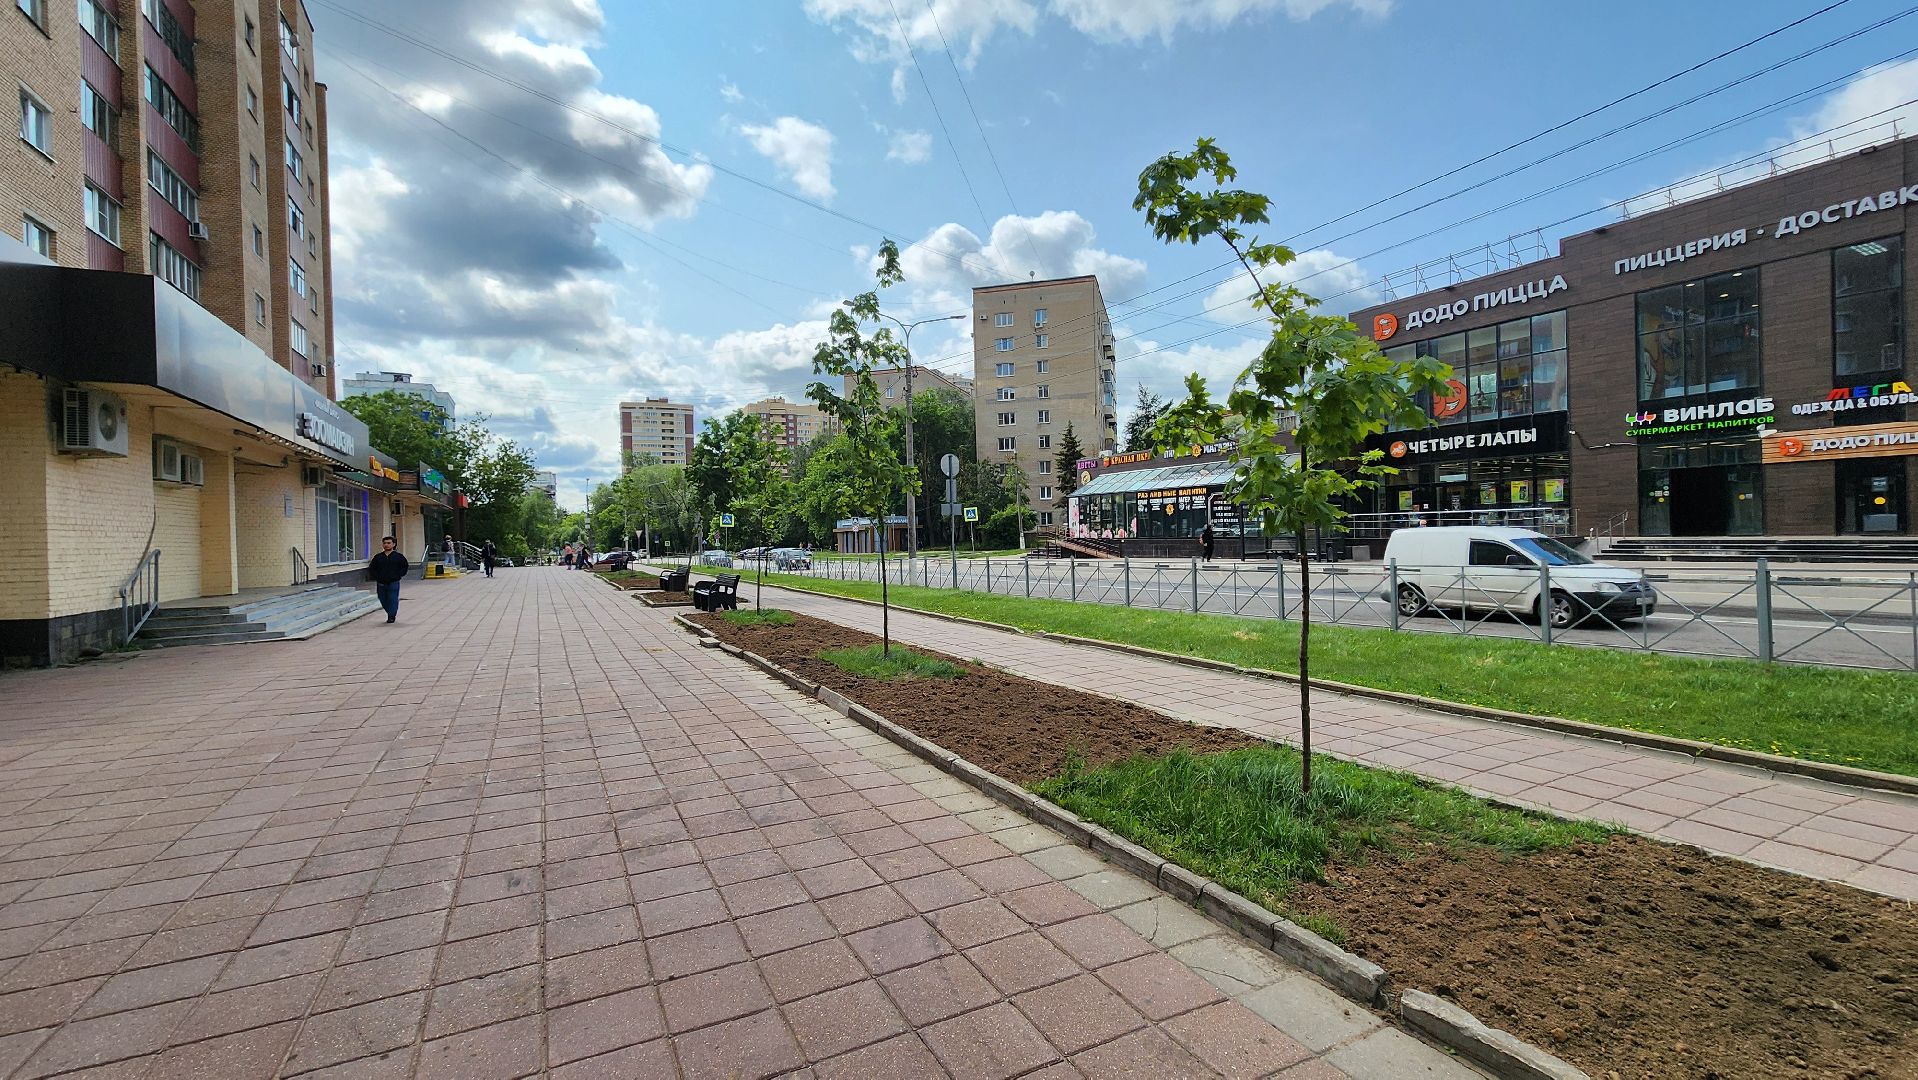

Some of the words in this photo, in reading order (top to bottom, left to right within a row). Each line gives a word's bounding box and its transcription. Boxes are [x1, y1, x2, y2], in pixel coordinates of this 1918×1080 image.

[1614, 228, 1747, 275] ПИЦЦЕРИЯ
[1774, 184, 1918, 239] ДОСТАВК
[1405, 299, 1469, 331] ДОДО
[1473, 274, 1568, 312] ПИЦЦА
[1791, 399, 1855, 415] ОДЕЖДА
[1857, 398, 1868, 409] &
[1869, 392, 1918, 407] ОБУВЬ
[1625, 422, 1703, 437] СУПЕРМАРКЕТ
[1707, 415, 1775, 430] НАПИТКОВ
[1408, 434, 1476, 454] ЧЕТЫРЕ
[1478, 428, 1537, 447] ЛАПЫ
[1811, 435, 1871, 452] ДОДО
